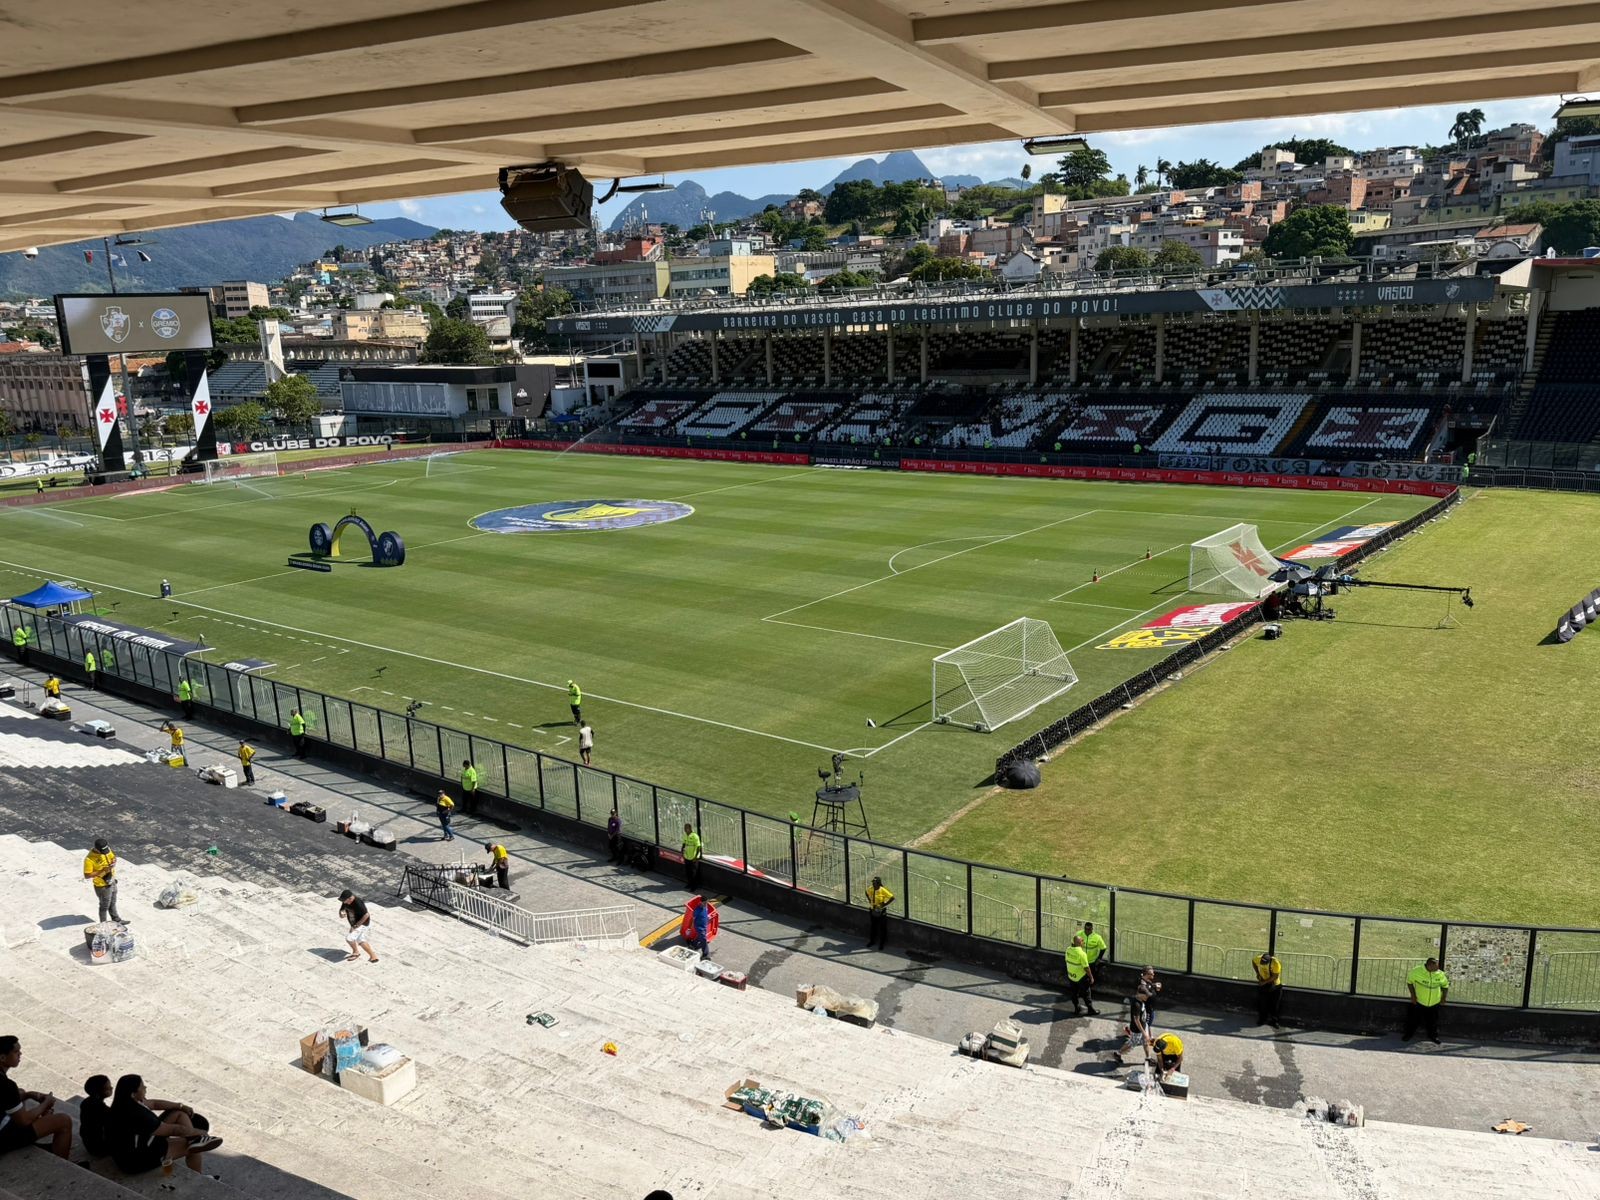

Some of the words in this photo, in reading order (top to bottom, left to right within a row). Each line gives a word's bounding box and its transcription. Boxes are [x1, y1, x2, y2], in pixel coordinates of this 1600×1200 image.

[1378, 285, 1414, 301] VASCO
[783, 314, 797, 325] DO
[891, 309, 905, 321] DO
[1043, 302, 1061, 314] DO
[1071, 298, 1118, 313] POVO!
[250, 438, 311, 452] CLUBE
[315, 437, 341, 448] DO
[346, 435, 393, 446] POVO
[815, 457, 860, 465] BRASILEIRÃO
[1227, 475, 1244, 485] bmg
[1252, 476, 1269, 486] bmg
[1281, 477, 1298, 487] bmg
[1311, 479, 1328, 489] bmg
[1341, 481, 1359, 491] bmg
